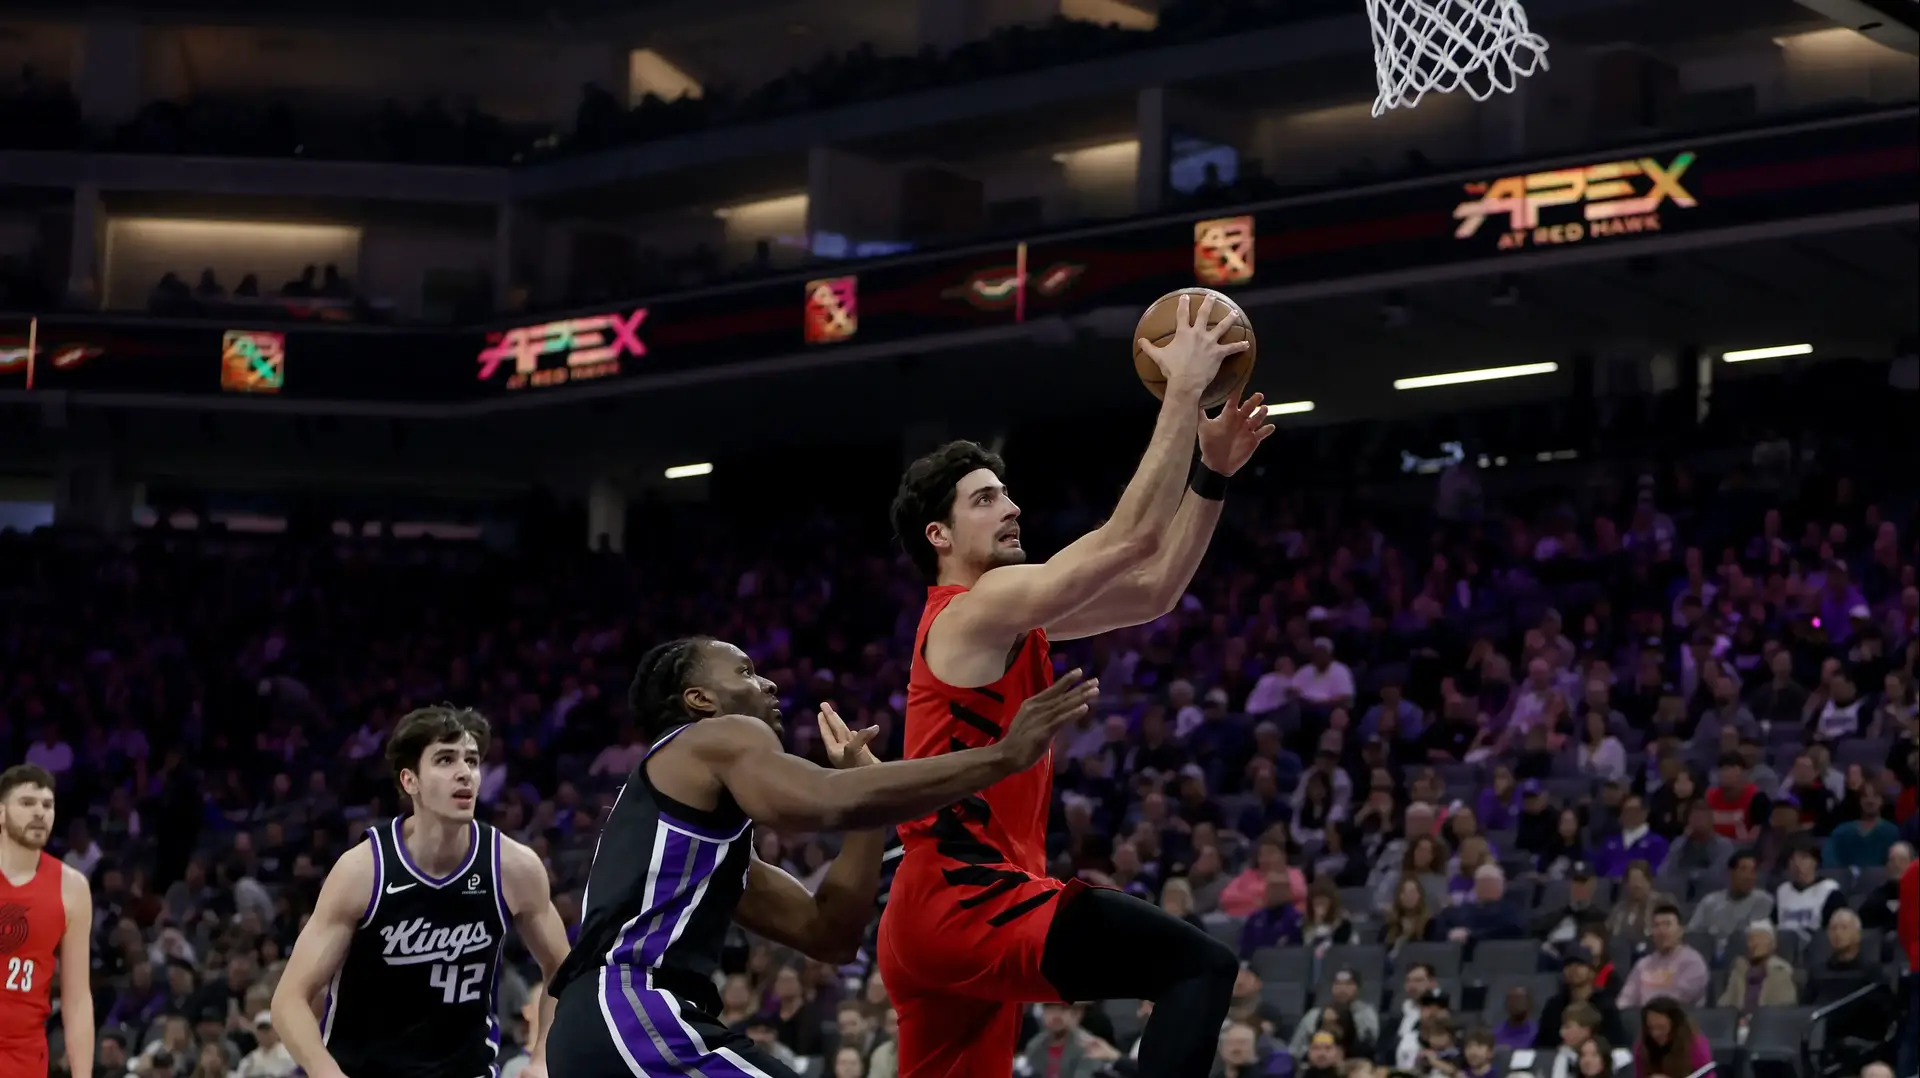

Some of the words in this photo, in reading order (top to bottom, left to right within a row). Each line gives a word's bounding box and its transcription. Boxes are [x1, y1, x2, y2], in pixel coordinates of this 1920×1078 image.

[1453, 152, 1698, 239] APEX
[1497, 229, 1527, 249] AT
[1533, 222, 1584, 245] RED
[1590, 213, 1660, 237] HAWK
[477, 308, 648, 381] APEX
[380, 917, 492, 964] Kings
[6, 956, 34, 992] 23
[430, 963, 486, 1003] 42
